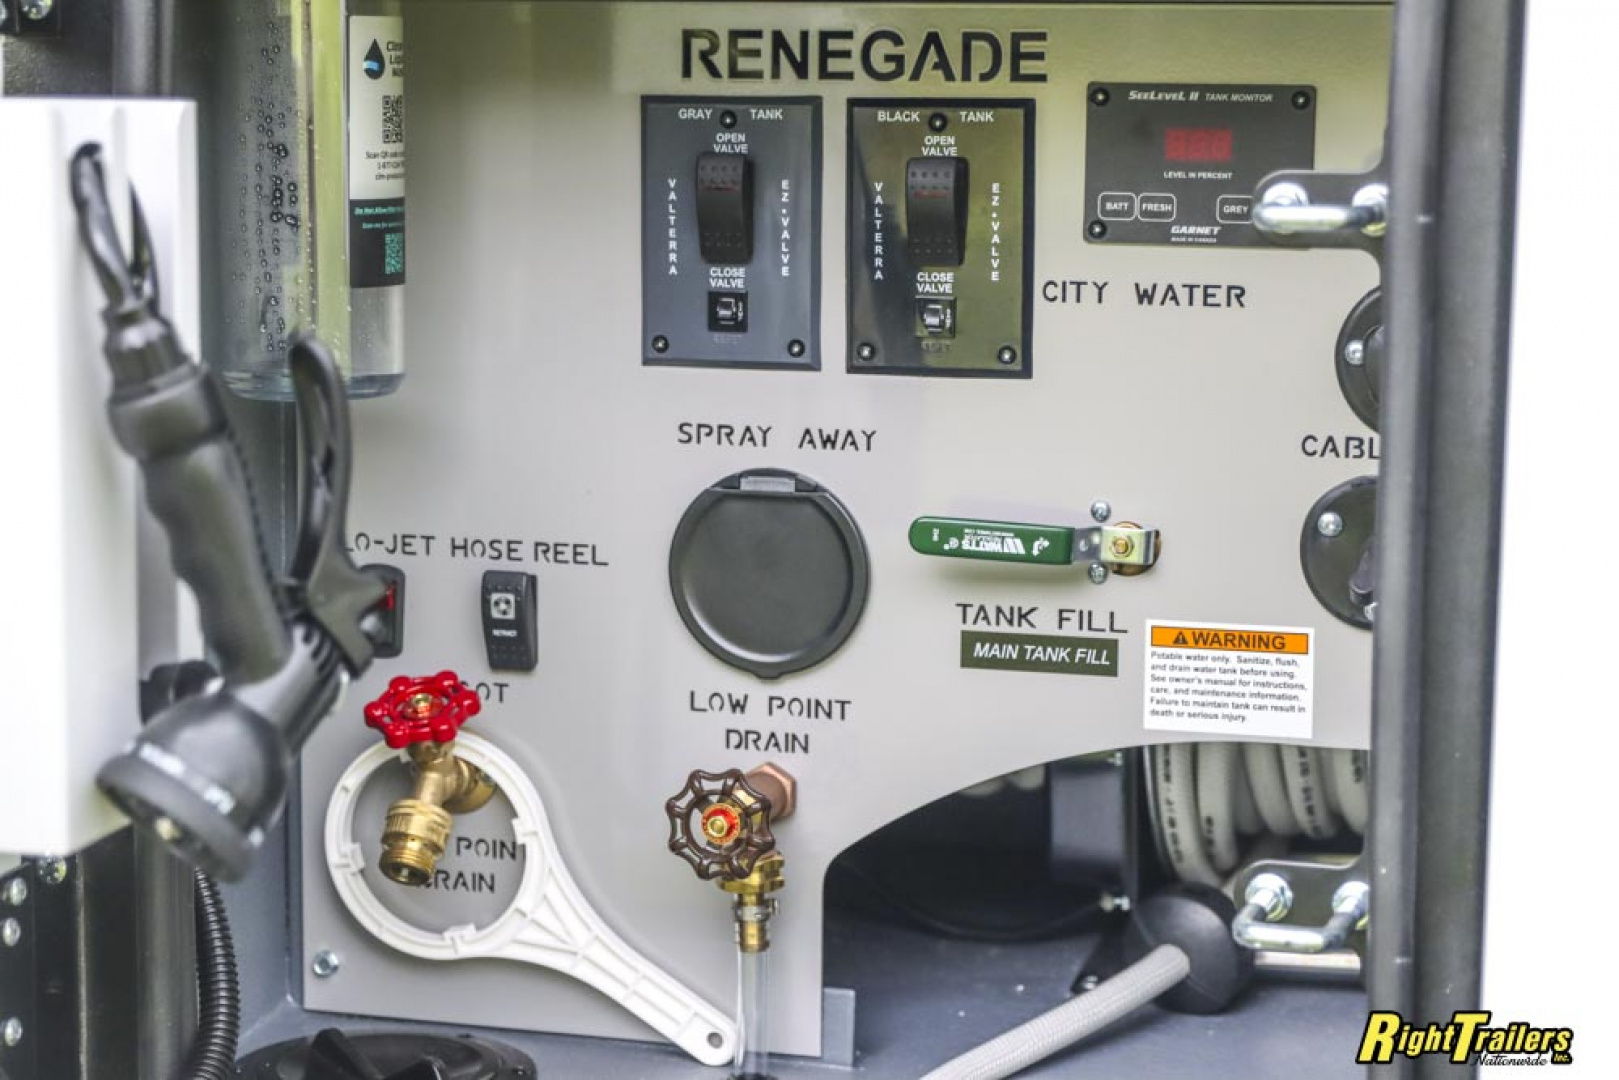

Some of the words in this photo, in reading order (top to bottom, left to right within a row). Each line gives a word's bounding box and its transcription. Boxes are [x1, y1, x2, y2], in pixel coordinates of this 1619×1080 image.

[682, 29, 1047, 83] RENEGADE
[1205, 93, 1229, 102] TANK
[1231, 93, 1273, 103] MONITOR
[678, 109, 712, 120] GRAY
[750, 109, 783, 120] TANK
[877, 111, 920, 122] BLACK
[960, 111, 994, 123] TANK
[716, 133, 745, 143] OPEN
[924, 136, 955, 146] OPEN
[713, 143, 748, 154] VALVE
[922, 146, 957, 157] VALVE
[1164, 171, 1187, 179] LEVEL
[1198, 172, 1233, 180] PERCENT
[1105, 201, 1129, 211] BATT
[1143, 203, 1172, 212] FRESH
[1223, 205, 1248, 214] GREY
[668, 179, 677, 275] VALTERRA
[874, 182, 883, 280] VALTERRA
[1171, 226, 1222, 236] GARNET
[710, 267, 746, 277] CLOSE
[917, 272, 954, 282] CLOSE
[709, 278, 745, 288] VALVE
[916, 283, 953, 293] VALVE
[1042, 280, 1109, 304] CITY
[1134, 282, 1246, 307] WATER
[677, 422, 772, 447] SPRAY
[798, 428, 877, 452] AWAY
[450, 537, 524, 561] HOSE
[534, 541, 609, 567] REEL
[956, 602, 1039, 629] TANK
[1058, 607, 1128, 634] FILL
[1192, 630, 1286, 650] WARNING
[973, 643, 1022, 660] MAIN
[1025, 644, 1072, 662] TANK
[1074, 647, 1111, 666] FILL
[1151, 650, 1182, 660] Potable
[1185, 654, 1209, 662] water
[1236, 655, 1273, 667] Sanitize,
[1169, 664, 1191, 672] drain
[1240, 667, 1267, 676] before
[1150, 673, 1167, 682] See
[1168, 676, 1202, 684] owner's
[1204, 678, 1236, 686] manual
[1238, 678, 1251, 687] for
[1173, 687, 1190, 695] and
[1191, 688, 1246, 698] maintenance
[690, 691, 748, 715] LOW
[769, 696, 852, 721] POINT
[1150, 696, 1179, 706] Failure
[1181, 699, 1191, 707] to
[1192, 700, 1230, 709] maintain
[1231, 702, 1250, 710] tank
[1252, 704, 1268, 712] can
[1270, 705, 1296, 713] result
[1150, 708, 1174, 717] death
[1187, 711, 1219, 720] serious
[725, 729, 809, 754] DRAIN
[425, 869, 495, 894] RAIN
